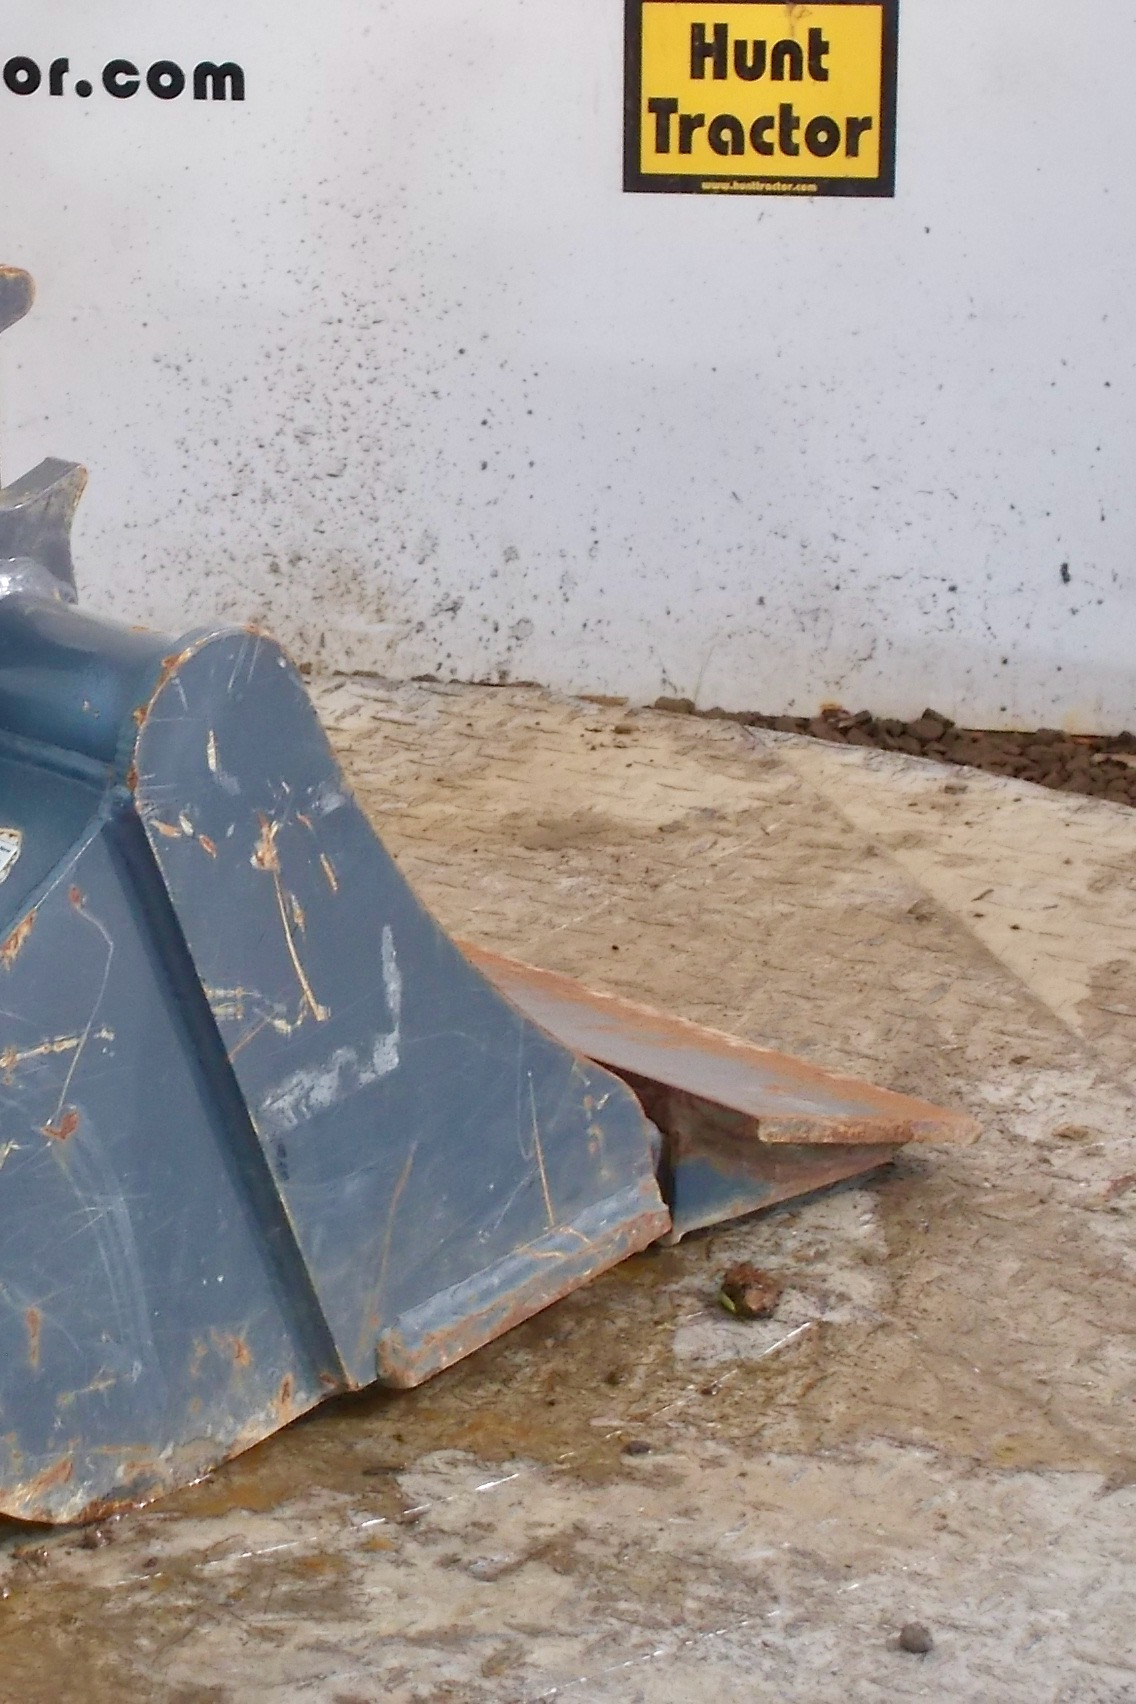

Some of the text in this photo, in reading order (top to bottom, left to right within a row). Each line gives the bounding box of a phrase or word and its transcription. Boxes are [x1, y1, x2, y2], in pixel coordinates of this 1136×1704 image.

[690, 22, 830, 82] Hunt
[647, 97, 873, 158] Tractor
[701, 180, 818, 192] www.hunttractor.com
